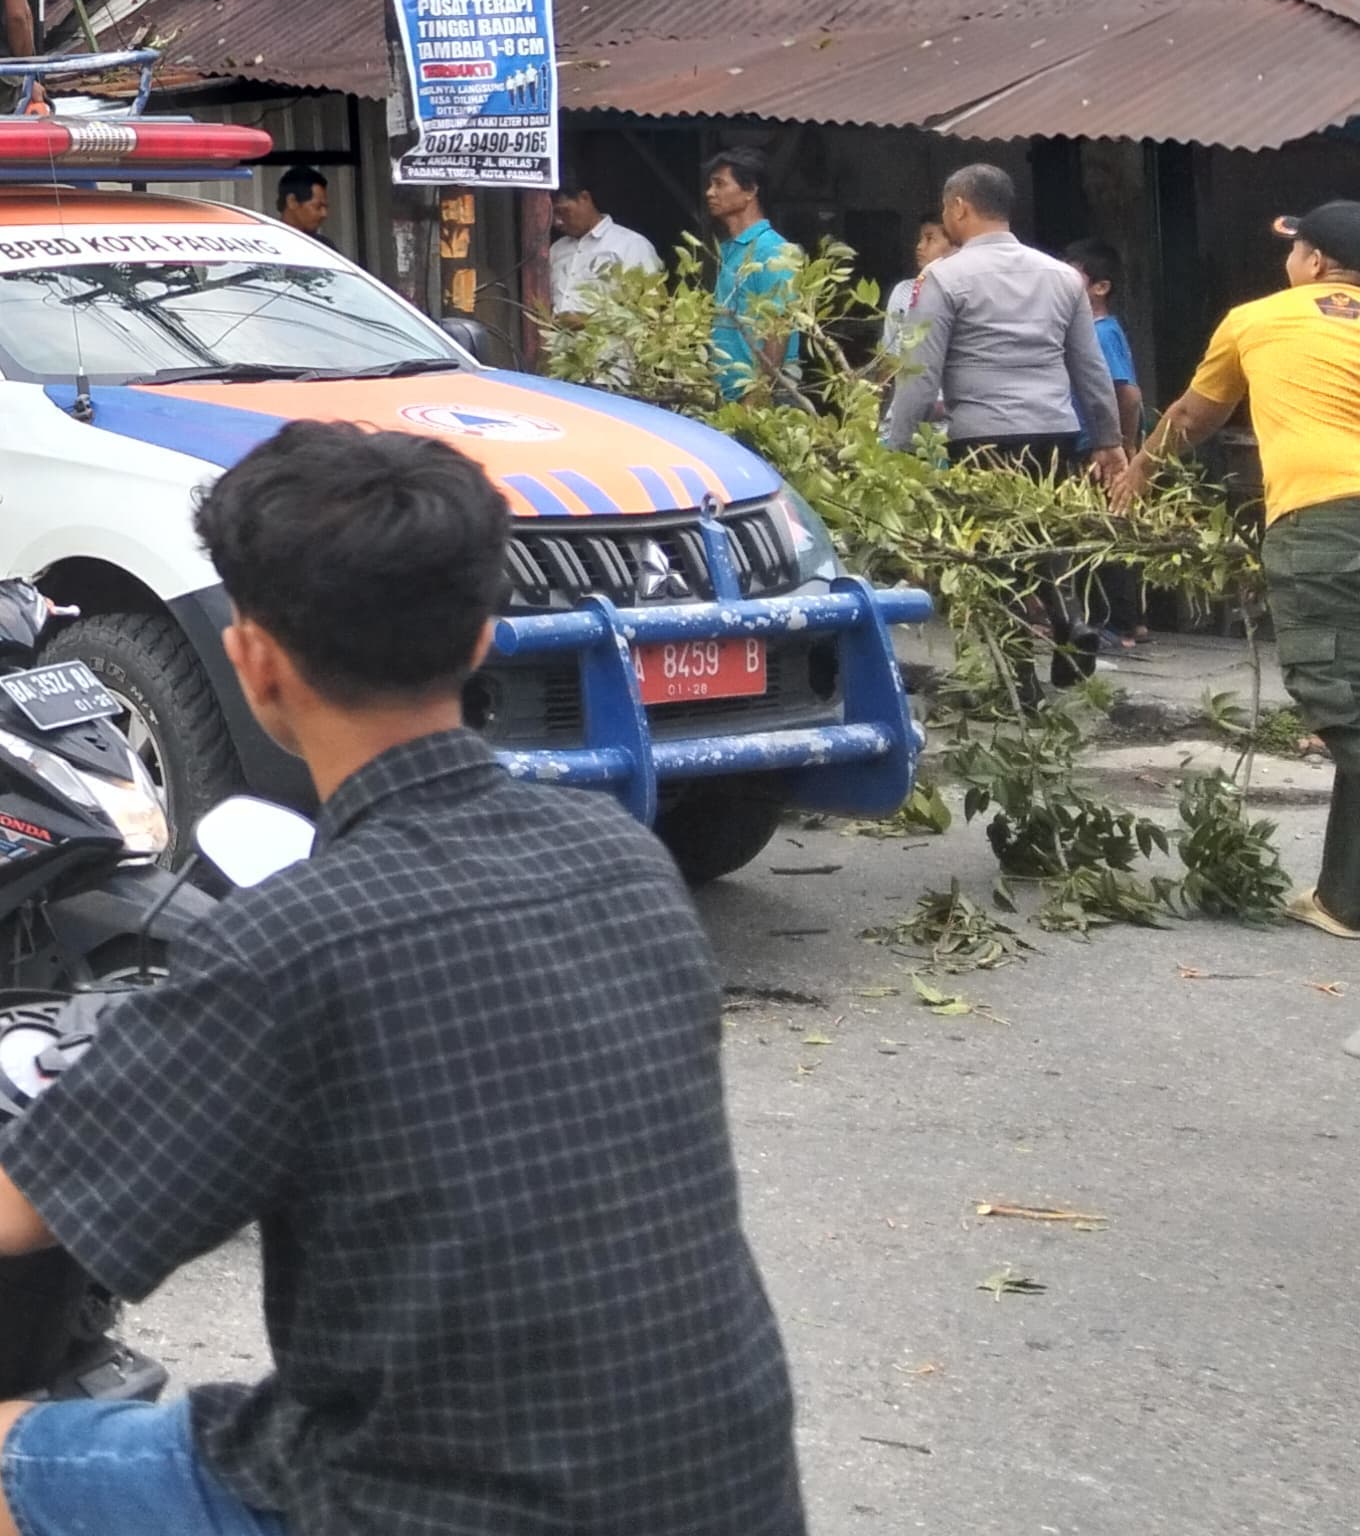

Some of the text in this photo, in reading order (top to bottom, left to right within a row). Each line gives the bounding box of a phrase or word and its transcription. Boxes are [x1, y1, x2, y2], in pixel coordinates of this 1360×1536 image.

[418, 17, 537, 38] TINGGI BADAN
[417, 37, 545, 59] TAMBAH 1-8 CM
[425, 131, 548, 154] 0812-9490-9165
[82, 235, 163, 253] KOTA
[164, 235, 282, 255] PADANG
[663, 641, 720, 679] 8459
[746, 638, 760, 673] B
[5, 679, 38, 703] BA
[30, 670, 76, 696] 3524
